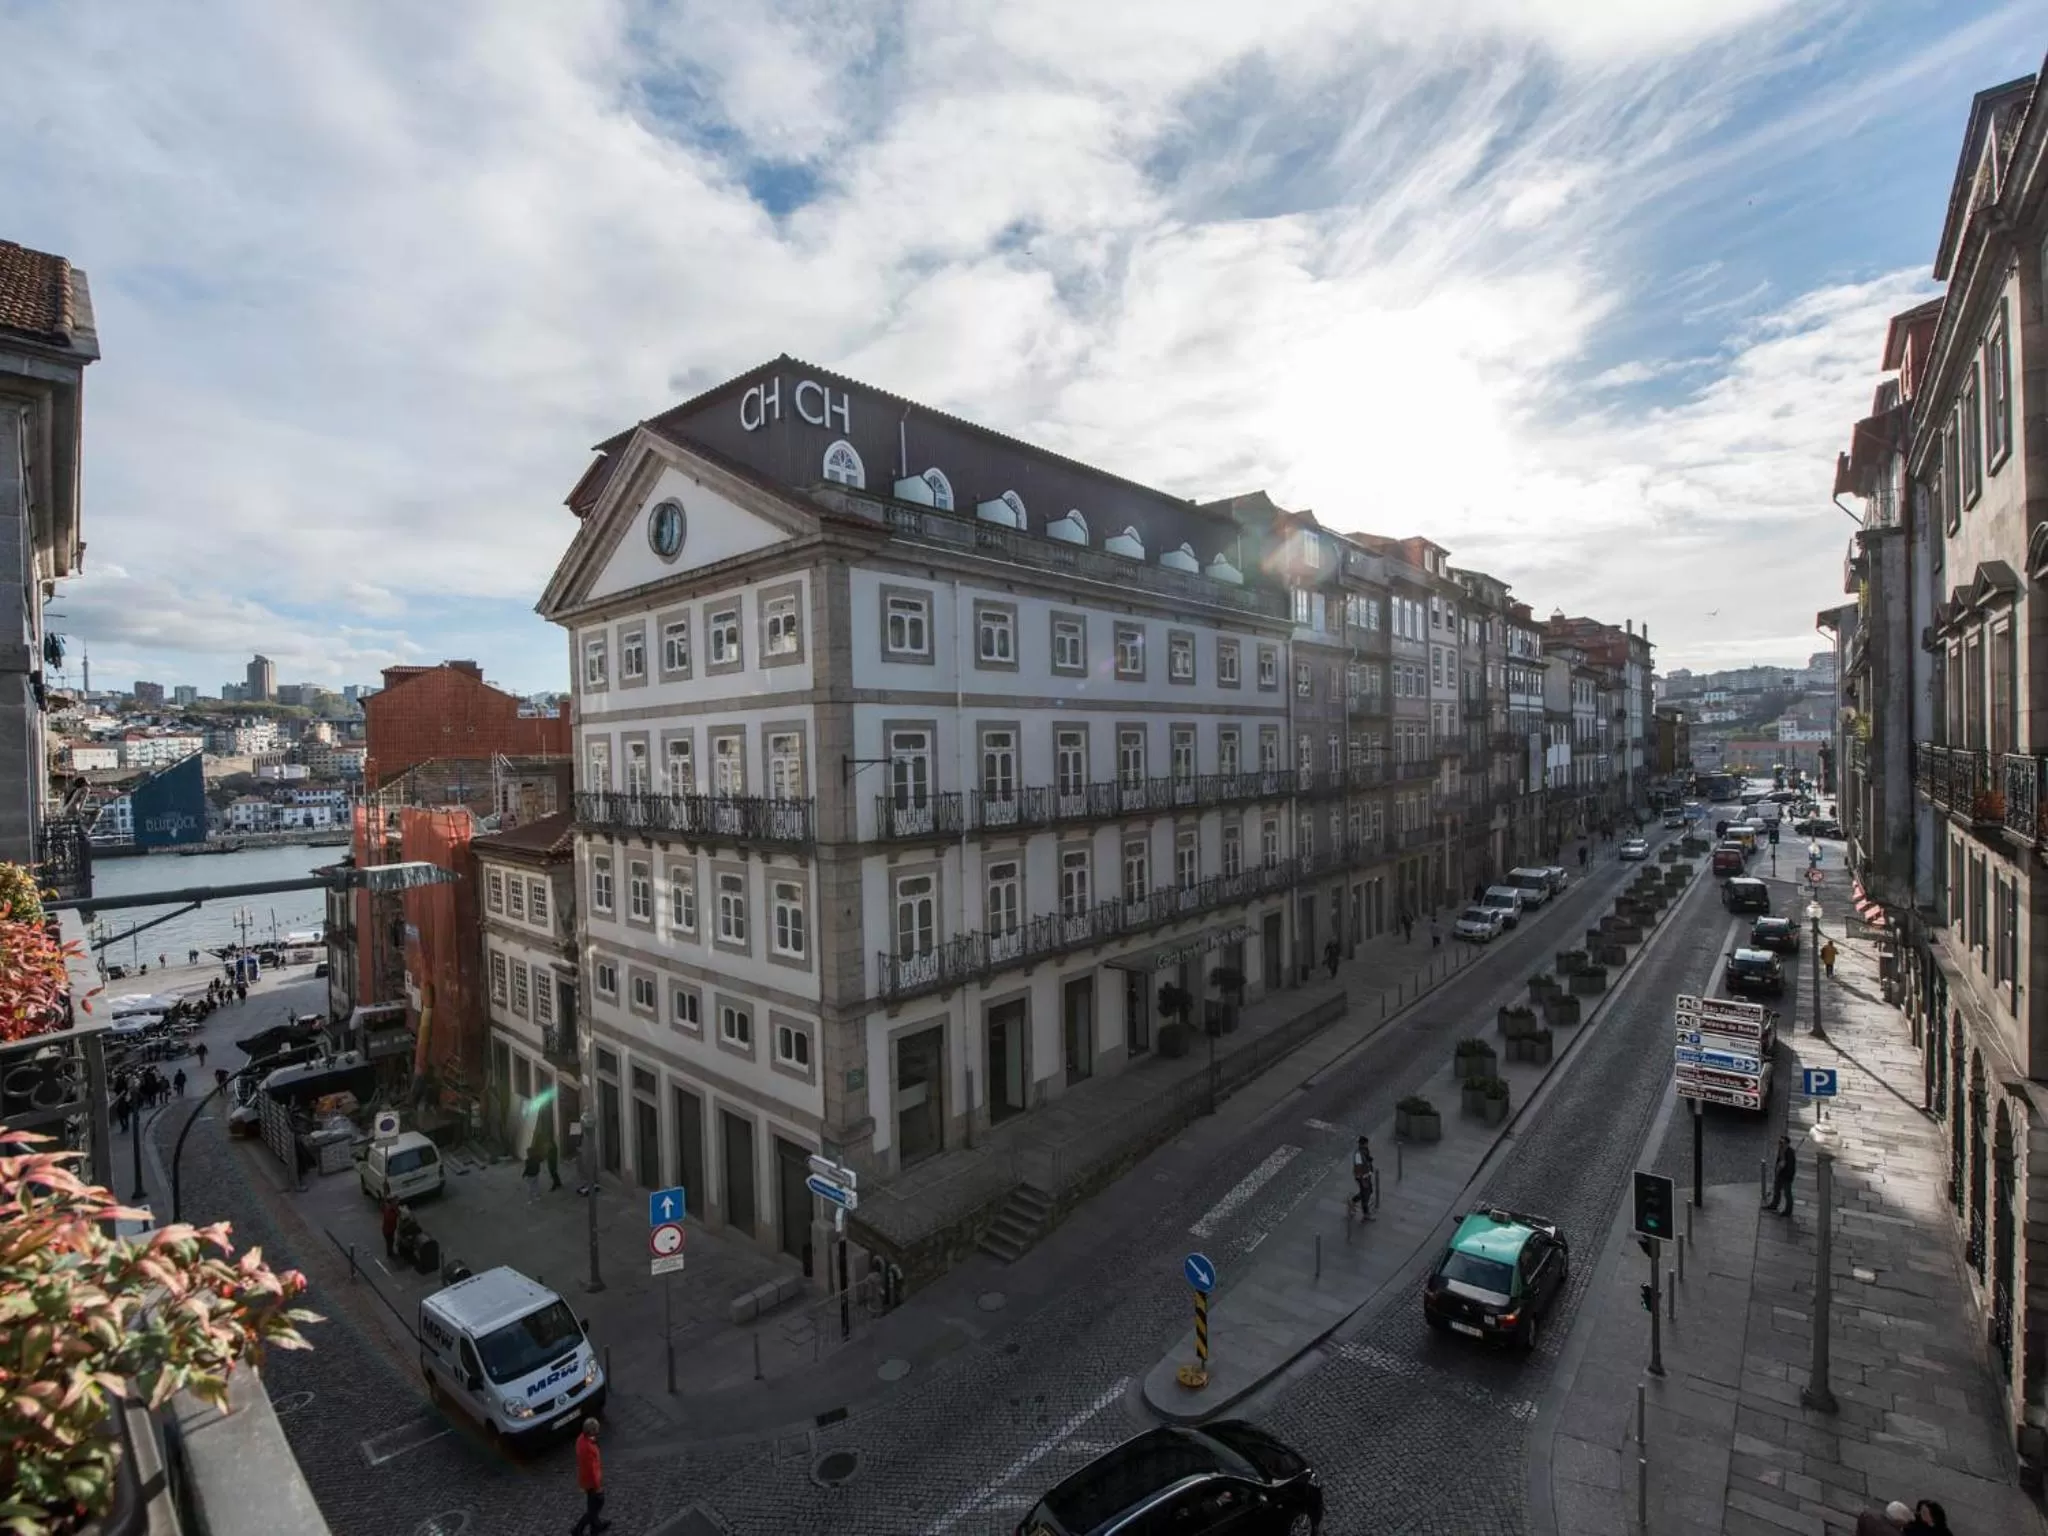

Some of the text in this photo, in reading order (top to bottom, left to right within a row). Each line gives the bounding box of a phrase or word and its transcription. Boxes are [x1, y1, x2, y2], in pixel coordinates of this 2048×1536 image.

[741, 376, 779, 431] CH
[796, 380, 850, 434] CH
[1811, 1071, 1829, 1093] P
[424, 1316, 455, 1351] MRW
[527, 1361, 579, 1397] MRW
